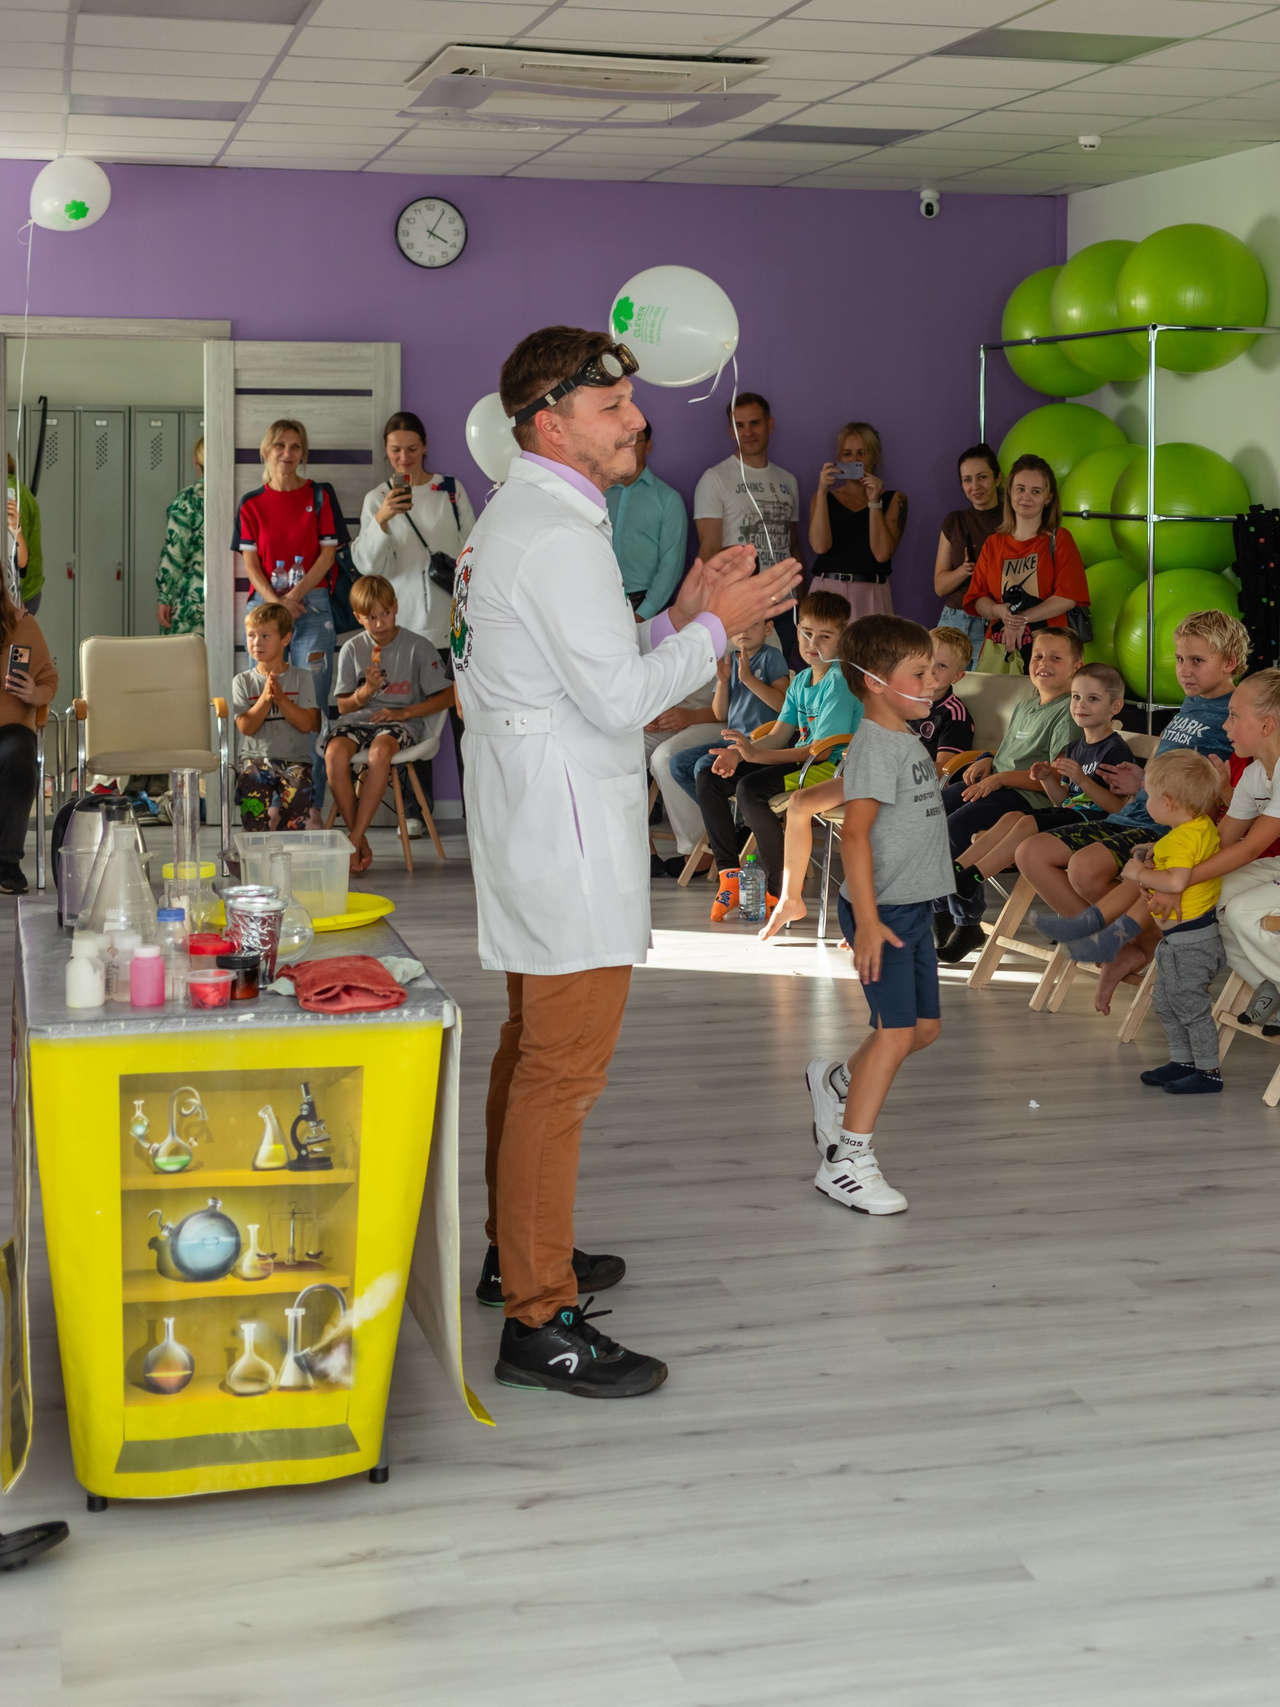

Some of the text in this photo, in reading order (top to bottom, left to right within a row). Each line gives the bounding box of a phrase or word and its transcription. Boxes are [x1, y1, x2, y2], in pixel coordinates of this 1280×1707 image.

[633, 305, 646, 338] CLEVER
[735, 483, 765, 493] JOHNS
[769, 483, 776, 493] &
[1005, 555, 1036, 577] NIKE
